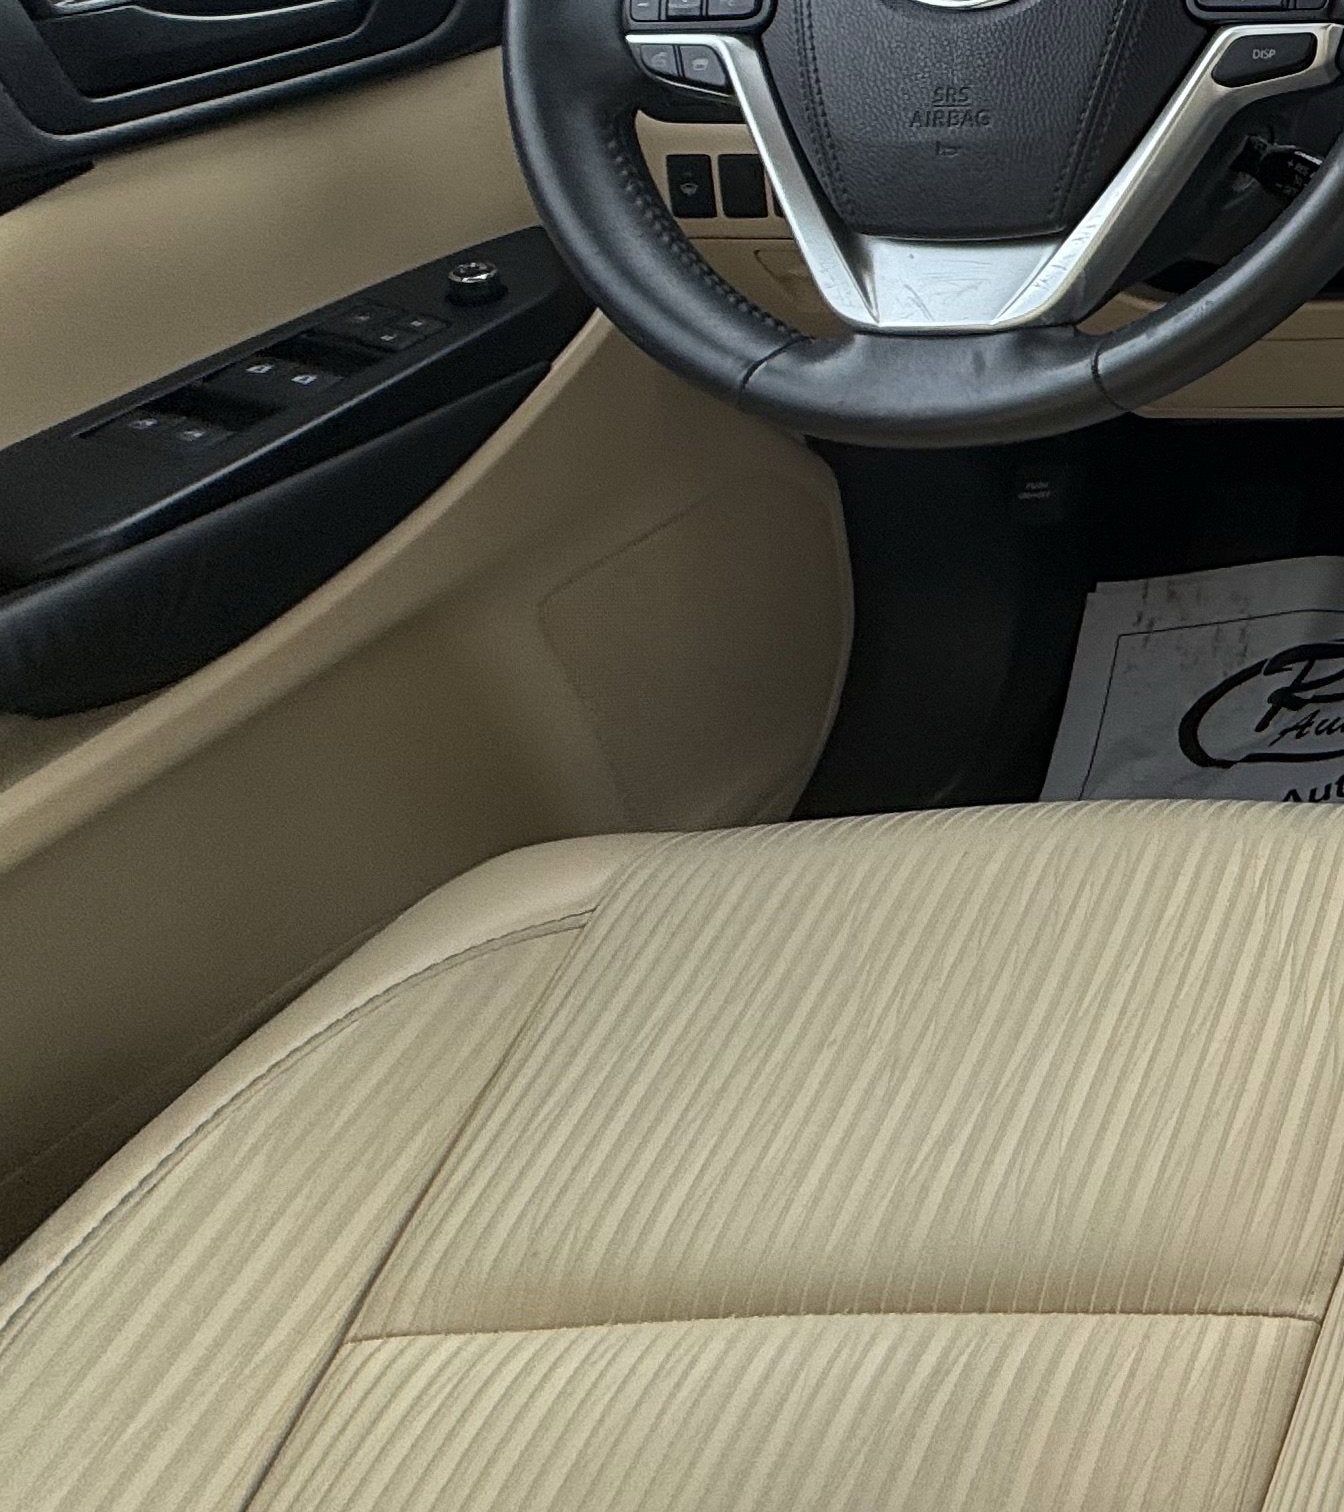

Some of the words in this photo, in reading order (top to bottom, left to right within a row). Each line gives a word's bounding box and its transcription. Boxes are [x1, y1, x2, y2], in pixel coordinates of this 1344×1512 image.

[1252, 48, 1276, 59] DISP
[932, 86, 971, 103] SRS
[909, 109, 991, 128] AIRBAG
